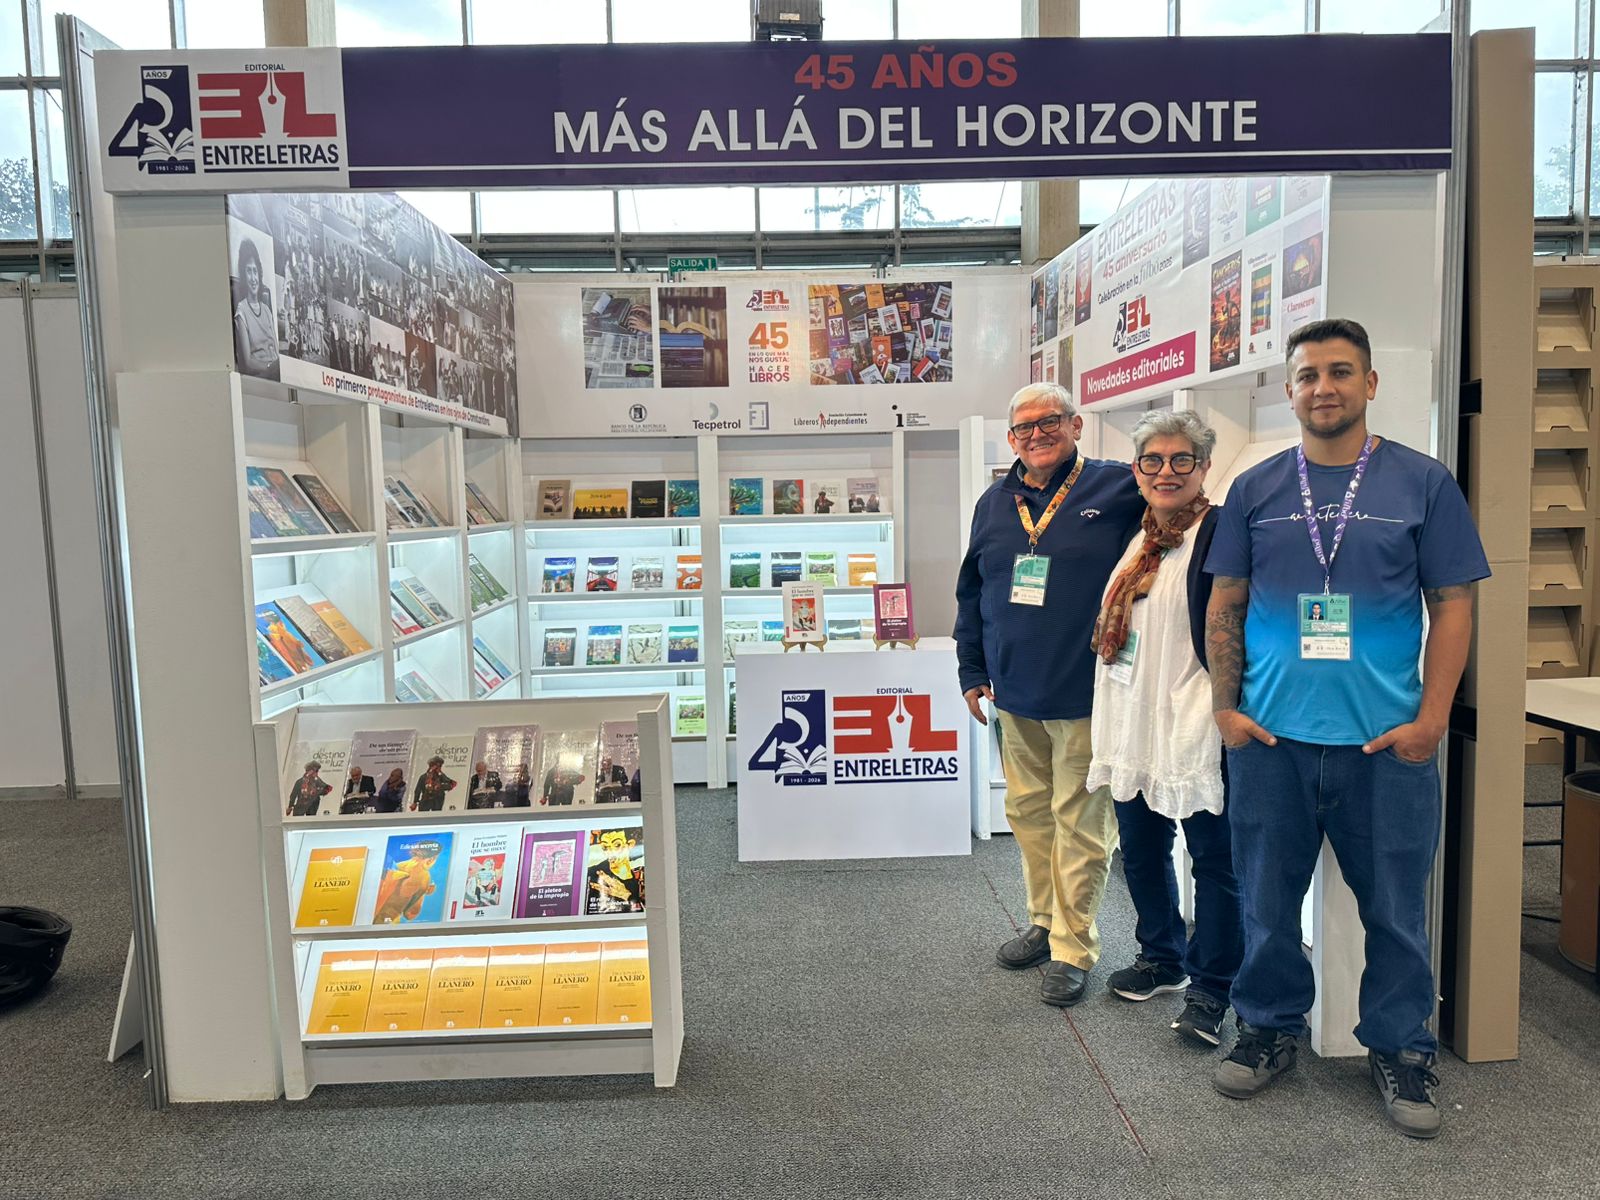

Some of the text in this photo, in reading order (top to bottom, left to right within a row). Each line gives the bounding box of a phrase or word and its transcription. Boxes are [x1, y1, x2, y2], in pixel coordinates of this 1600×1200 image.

[244, 63, 286, 72] EDITORIAL
[795, 44, 1018, 90] 45 AÑOS
[145, 70, 168, 79] AÑOS
[553, 96, 1258, 156] MÁS ALLÁ DEL HORIZONTE
[203, 144, 339, 166] ENTRELETRAS
[1098, 181, 1177, 262] ENTRELETRAS
[1103, 230, 1168, 281] 45 aniversario
[670, 259, 704, 267] SALIDA
[748, 322, 789, 349] 45
[1087, 348, 1184, 395] Novedades editoriales
[749, 372, 790, 383] LIBROS
[322, 371, 335, 387] Los
[335, 375, 367, 395] primeros
[692, 419, 741, 431] Tecpetrol
[793, 417, 819, 426] Libreros
[876, 687, 913, 695] EDITORIAL
[435, 745, 469, 755] destino
[313, 751, 346, 760] destino
[834, 757, 958, 778] ENTRELETRAS
[481, 840, 507, 848] hombre
[313, 880, 350, 888] LLANERO
[553, 976, 589, 984] LLANERO
[609, 974, 645, 982] LLANERO
[495, 979, 532, 987] LLANERO
[325, 984, 361, 992] LLANERO
